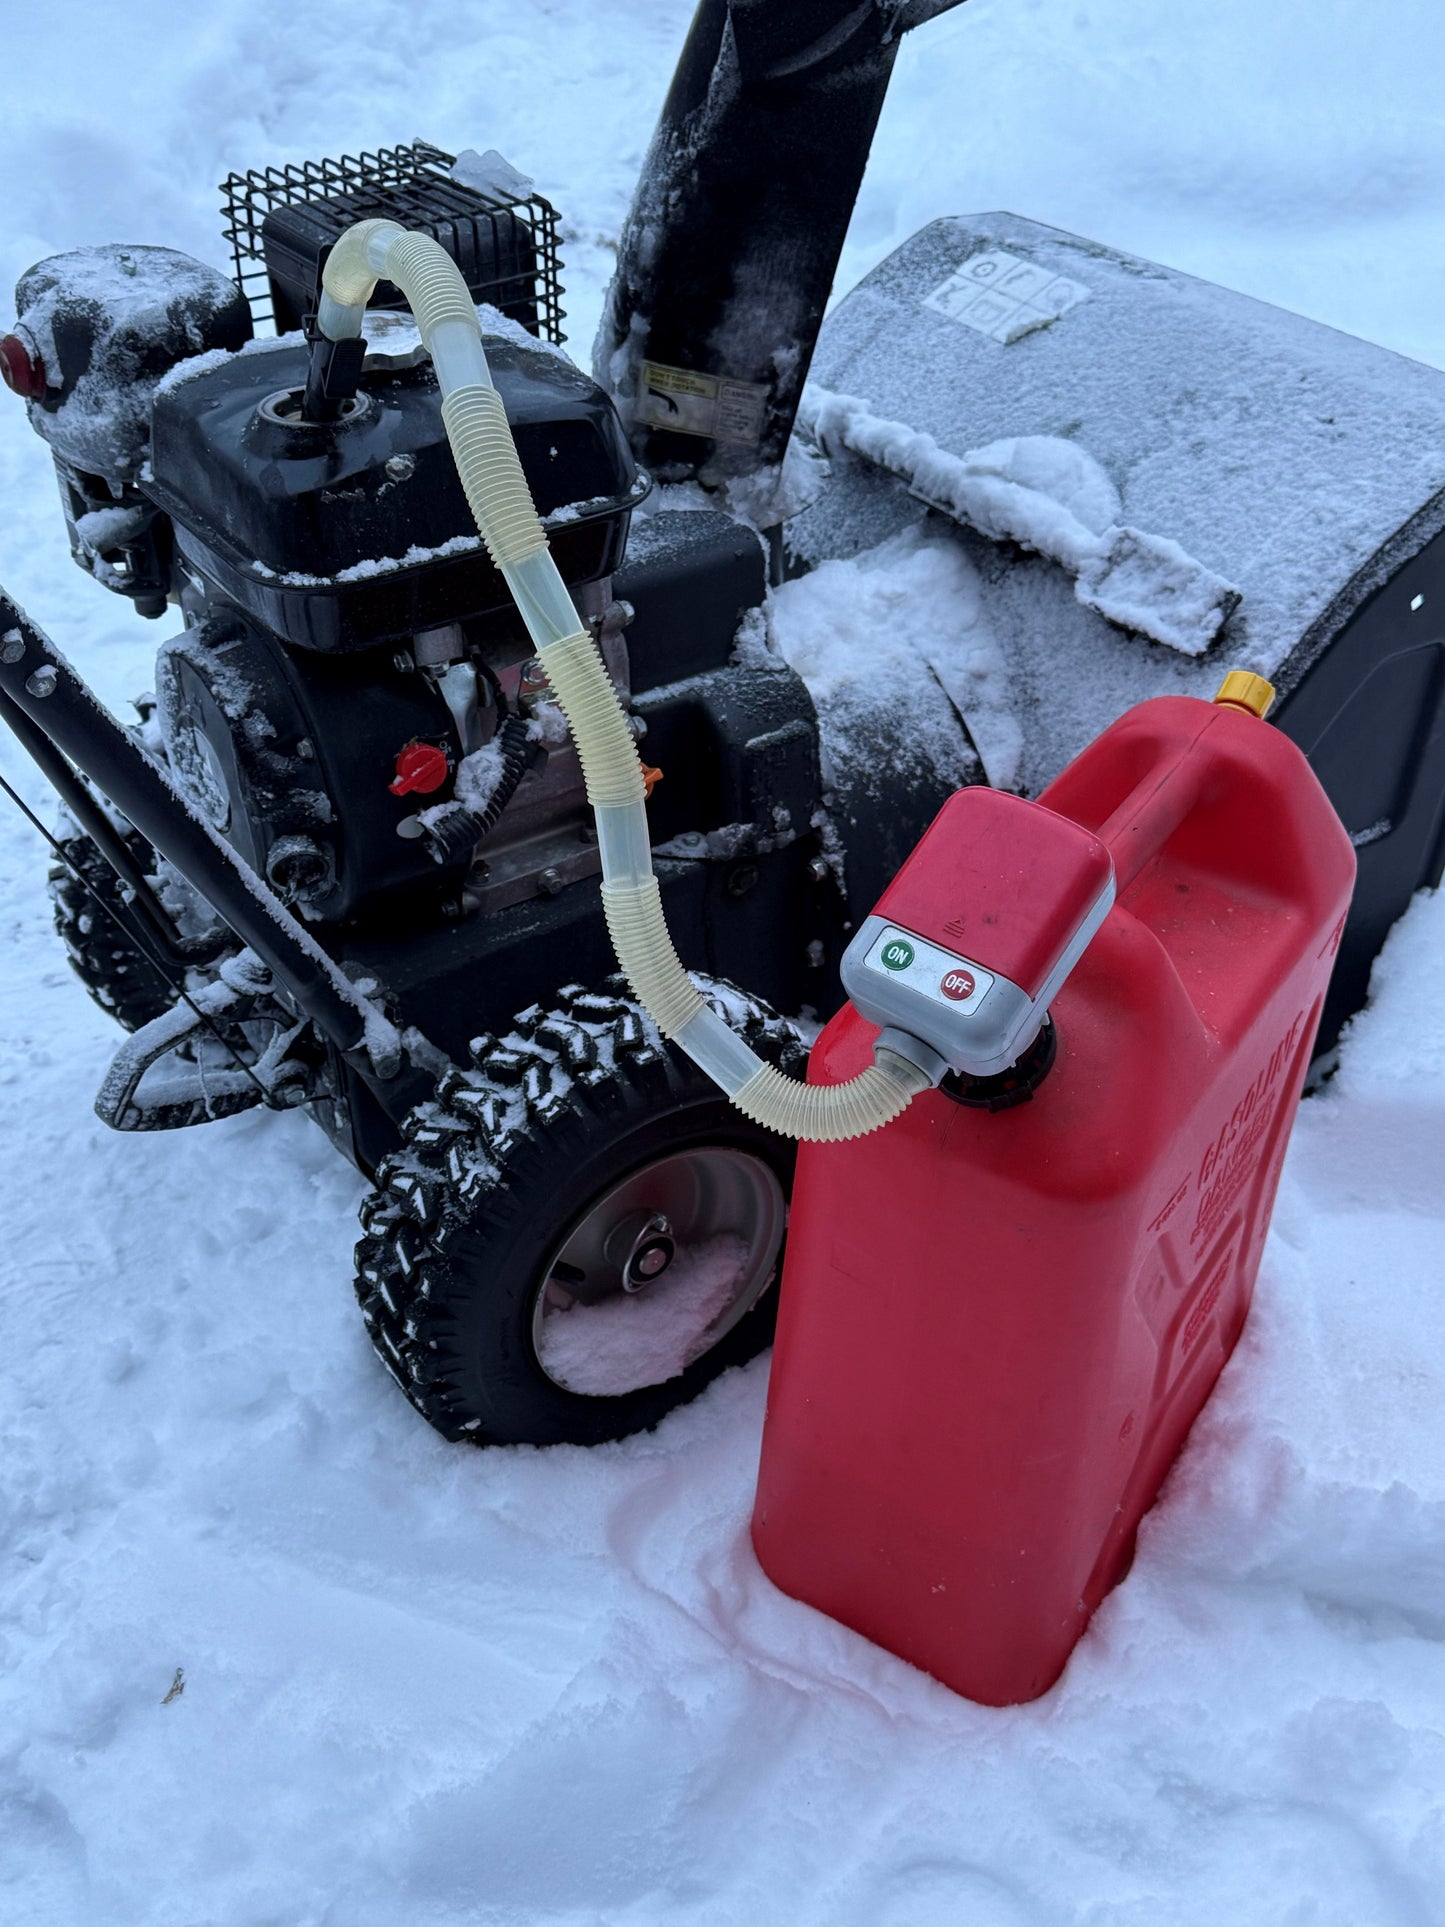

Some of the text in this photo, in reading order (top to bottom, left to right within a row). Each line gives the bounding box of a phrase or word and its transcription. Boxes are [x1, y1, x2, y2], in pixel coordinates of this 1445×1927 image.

[887, 946, 909, 964] ON
[945, 974, 972, 993] OFF
[1198, 1010, 1304, 1190] GASOLINE
